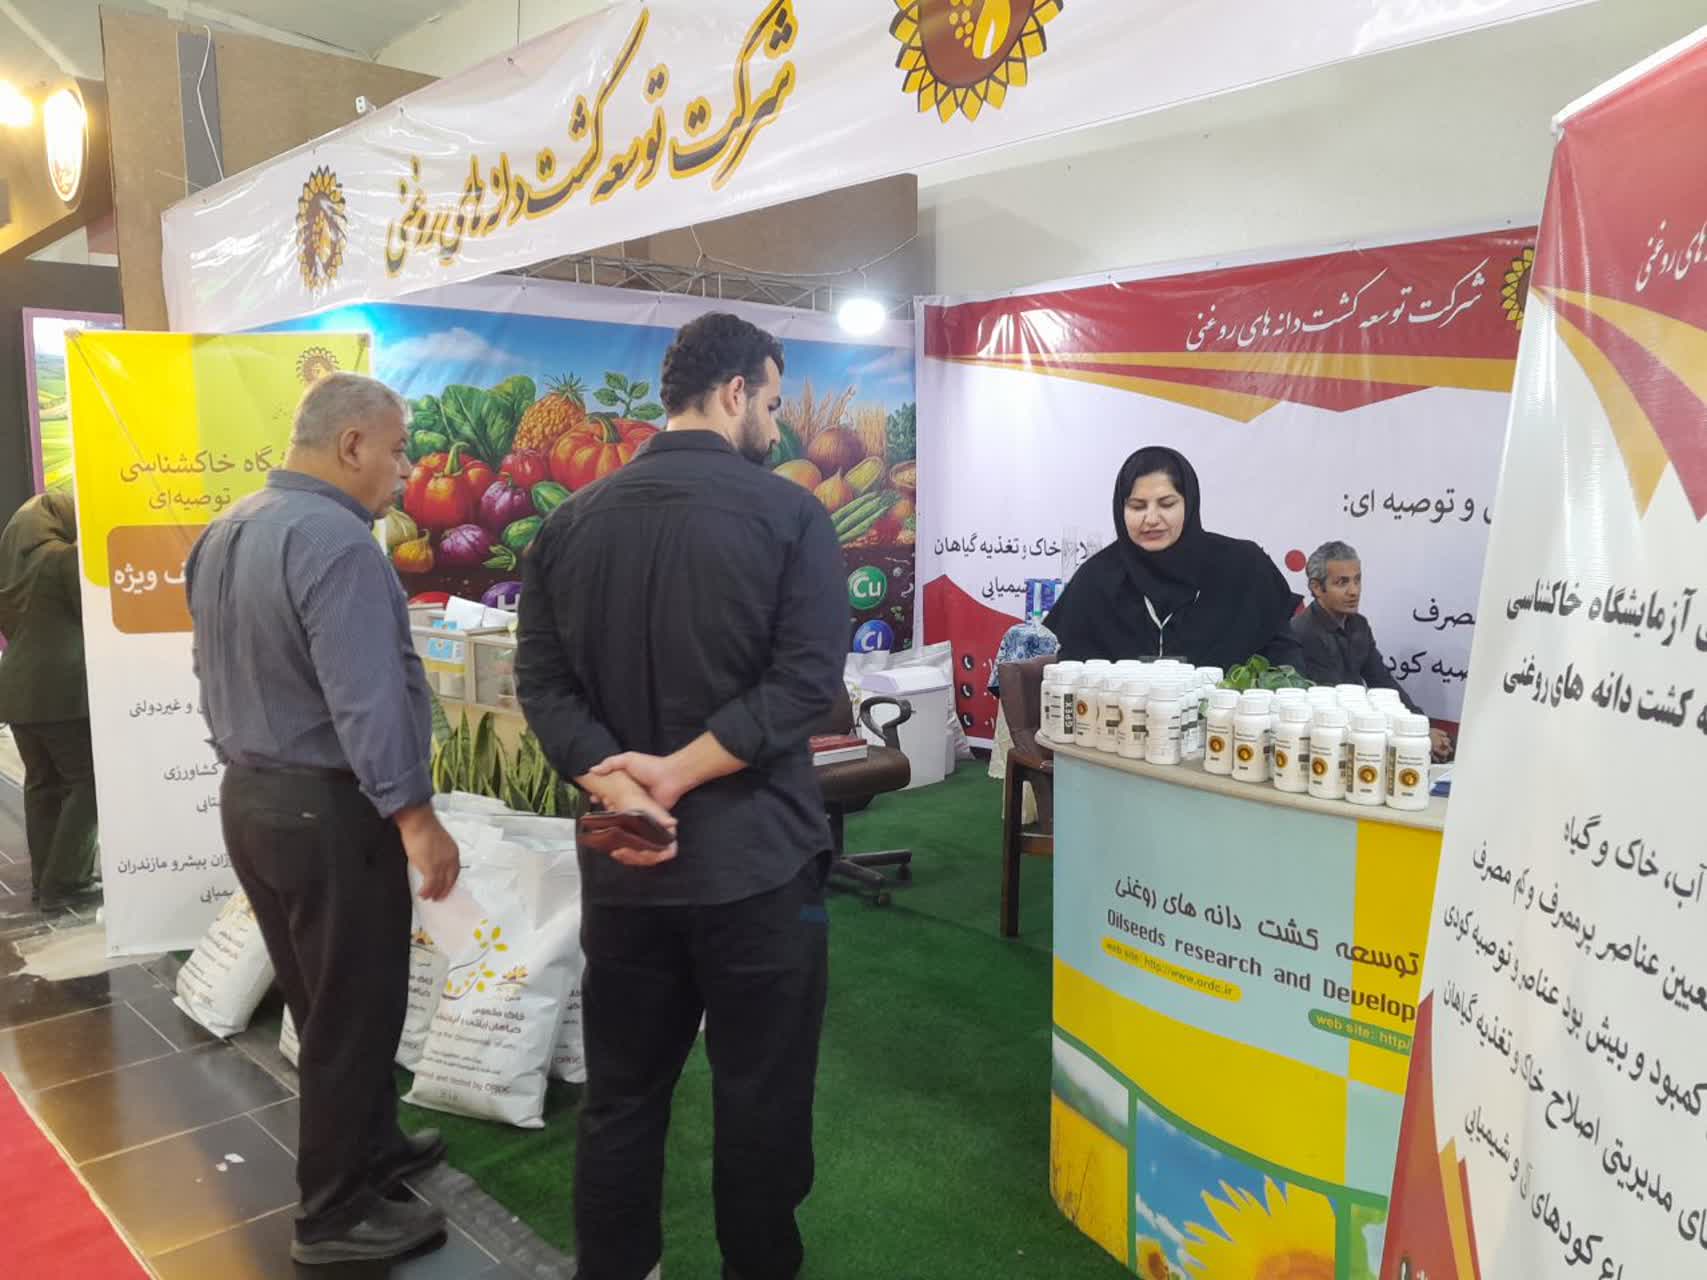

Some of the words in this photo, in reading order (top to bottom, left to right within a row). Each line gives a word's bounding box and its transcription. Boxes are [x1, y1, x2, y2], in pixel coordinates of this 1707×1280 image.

[525, 6, 650, 219] کشت
[669, 0, 798, 191] شرکت
[590, 63, 669, 205] توسعه
[481, 151, 529, 238] دانه
[1301, 266, 1388, 333] کشت
[1358, 285, 1413, 329] توسعه
[1407, 255, 1491, 329] شرکت
[1185, 303, 1237, 352] روغنی
[1237, 306, 1270, 347] های
[1272, 311, 1302, 337] دانه
[1382, 488, 1456, 524] توصیه
[1459, 496, 1476, 522] و
[934, 533, 978, 557] گیاهان
[979, 537, 1020, 560] تغذیه
[114, 562, 158, 596] ویژه
[853, 575, 882, 598] Cu
[1506, 577, 1583, 621] خاکشناسی
[1588, 585, 1698, 647] آزمایشگاه
[861, 630, 883, 652] Cl
[1385, 650, 1428, 681] کود
[1503, 654, 1550, 705] روغنی
[1550, 661, 1585, 709] های
[1591, 671, 1633, 714] دانه
[1637, 684, 1696, 728] کشت
[1472, 839, 1512, 885] مصرف
[1591, 840, 1609, 868] و
[1615, 838, 1659, 878] خاک
[1114, 875, 1157, 910] روغنی
[1162, 892, 1197, 919] های
[1204, 904, 1243, 931] دانه
[1257, 917, 1320, 951] کشت
[1107, 908, 1167, 947] Oilseeds
[1175, 938, 1263, 977] research
[1274, 967, 1312, 992] and
[1323, 977, 1416, 1023] Develop
[1334, 941, 1420, 979] توسعه
[1595, 935, 1660, 976] عناصر
[1315, 1014, 1343, 1031] web
[1585, 1015, 1629, 1072] بیش
[1628, 1051, 1645, 1081] و
[1464, 1104, 1511, 1163] شیمیایی
[1544, 1089, 1601, 1146] اصلاح
[1602, 1137, 1673, 1213] مدیریتی
[1531, 1191, 1604, 1267] کودهای
